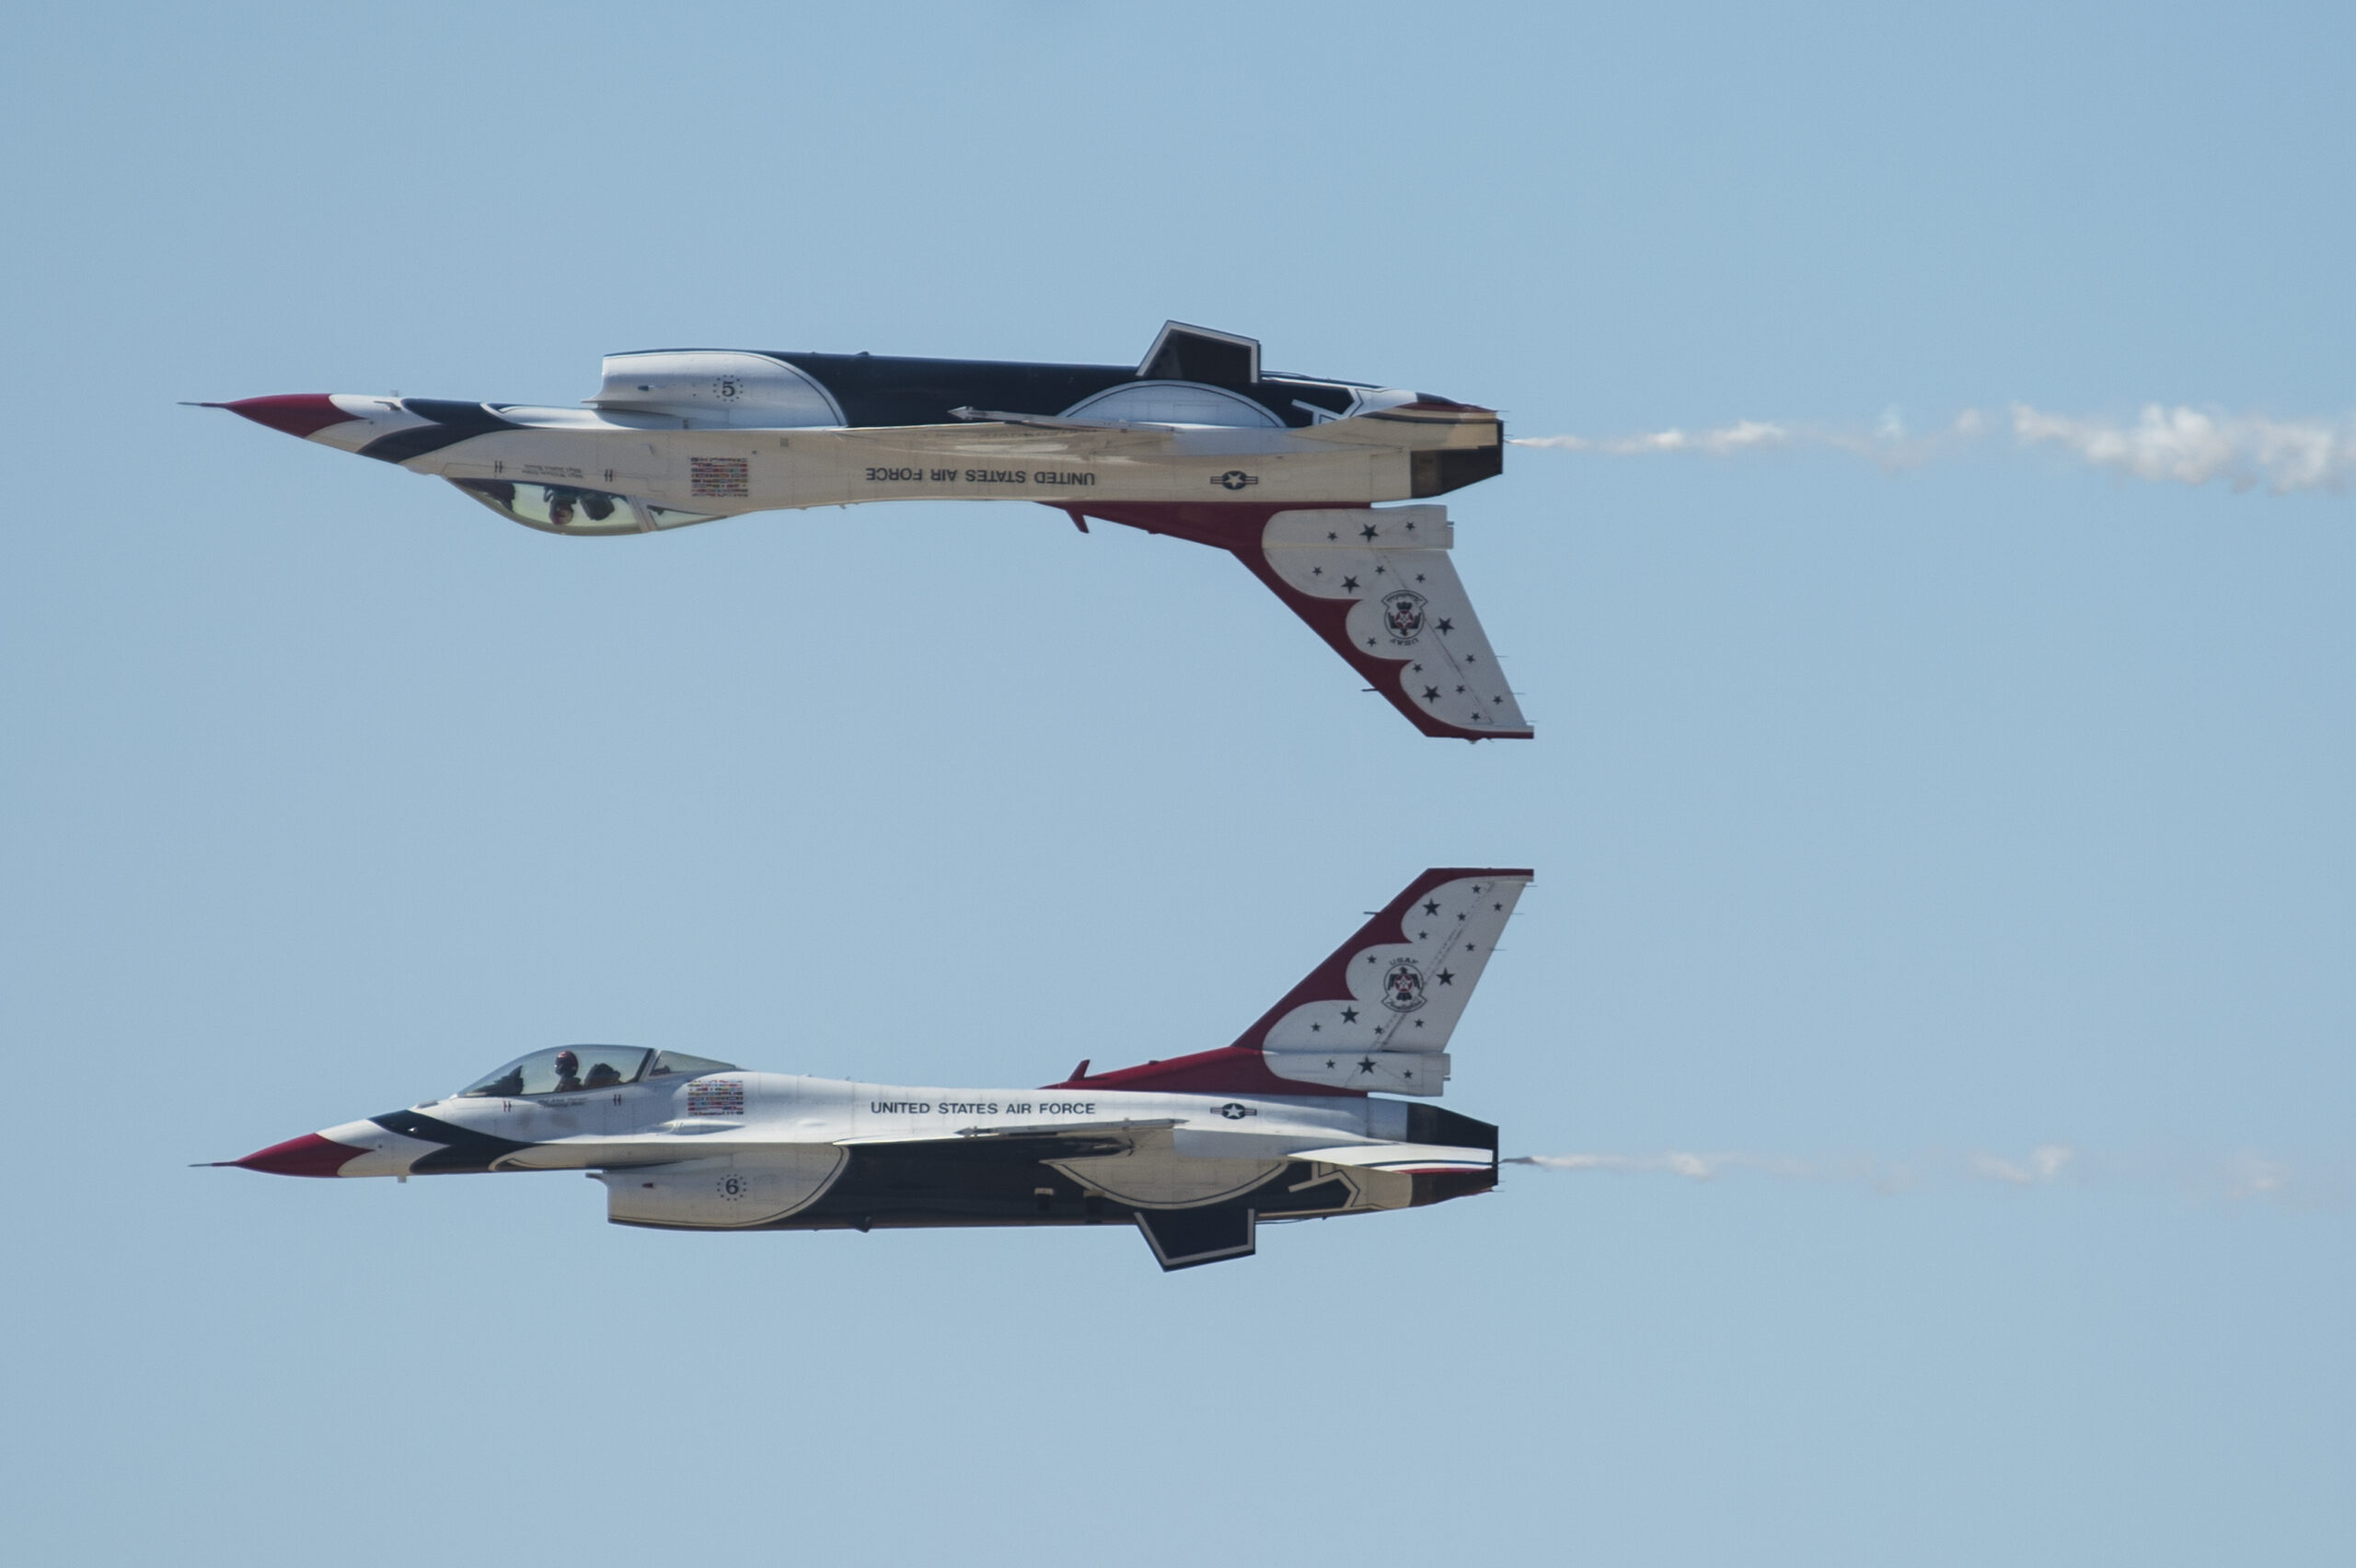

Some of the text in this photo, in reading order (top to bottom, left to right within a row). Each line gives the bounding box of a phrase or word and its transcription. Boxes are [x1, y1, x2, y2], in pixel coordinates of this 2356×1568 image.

[722, 381, 735, 397] 5
[865, 467, 1095, 485] UNITED STATES AIR FORCE
[871, 1101, 1095, 1114] UNITED STATES AIR FORCE
[725, 1178, 739, 1195] 6
